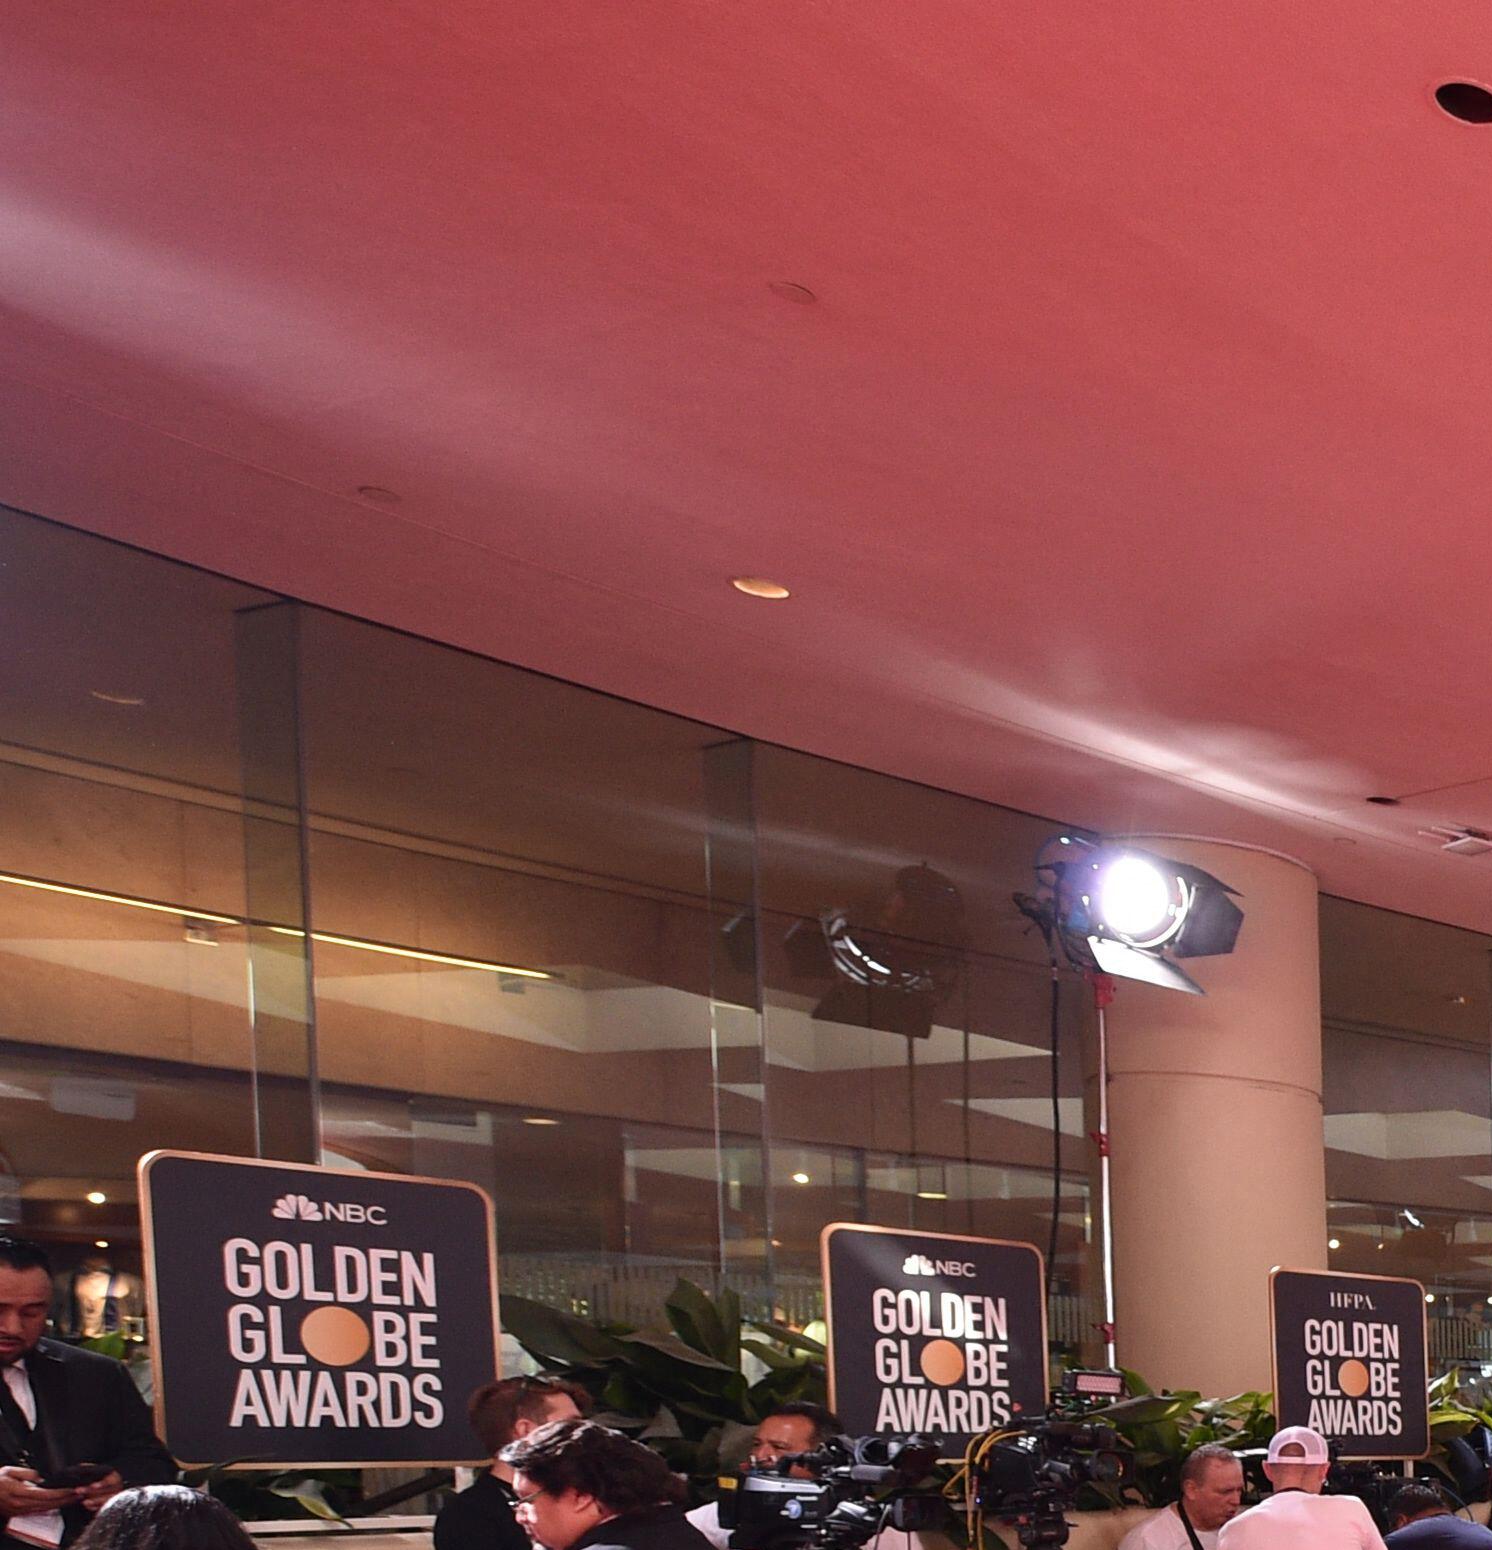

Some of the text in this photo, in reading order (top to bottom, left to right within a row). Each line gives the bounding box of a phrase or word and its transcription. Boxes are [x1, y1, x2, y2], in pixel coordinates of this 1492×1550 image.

[324, 1201, 388, 1225] NBC
[224, 1237, 438, 1308] GOLDEN
[935, 1259, 977, 1278] NBC
[228, 1303, 441, 1369] GLOBE
[872, 1287, 1008, 1341] GOLDEN
[875, 1337, 1010, 1388] GLOBE
[1304, 1318, 1400, 1360] GOLDEN
[229, 1368, 445, 1429] AWARDS
[1305, 1358, 1402, 1398] GLOBE
[875, 1387, 1012, 1434] AWARDS
[1307, 1398, 1403, 1437] AWARDS
